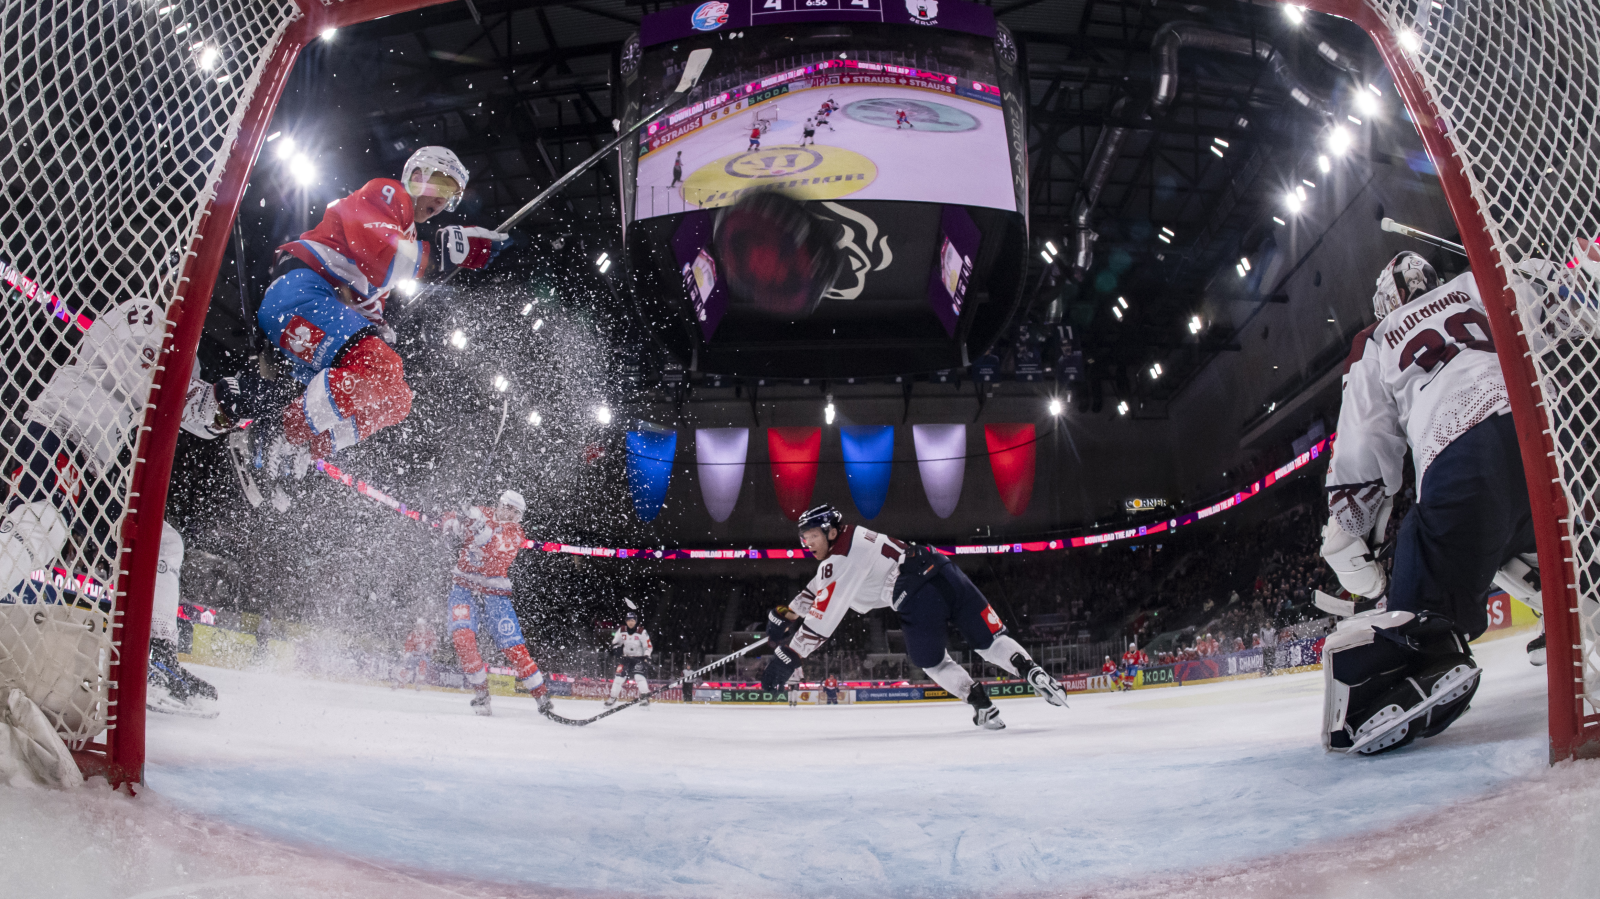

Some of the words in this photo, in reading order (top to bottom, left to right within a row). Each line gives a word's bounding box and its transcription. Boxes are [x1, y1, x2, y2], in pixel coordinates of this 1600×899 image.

[909, 16, 938, 26] BERLIN
[852, 76, 896, 84] STRAUSS
[909, 79, 952, 93] STRAUSS
[661, 120, 700, 145] STRAUSS
[382, 184, 396, 205] 9
[363, 221, 403, 234] STADL
[1275, 460, 1295, 480] DOWNLOAD
[1198, 503, 1221, 519] DOWNLOAD
[1084, 533, 1115, 544] DOWNLOAD
[1115, 531, 1125, 540] THE
[1125, 529, 1136, 538] APP
[561, 544, 592, 554] DOWNLOAD
[592, 547, 603, 556] THE
[603, 548, 616, 557] APP
[690, 550, 722, 558] DOWNLOAD
[723, 550, 734, 558] THE
[734, 550, 746, 558] APP
[955, 546, 987, 554] DOWNLOAD
[999, 545, 1010, 553] APP
[821, 563, 833, 580] 18
[1062, 679, 1086, 690] TRAUSS
